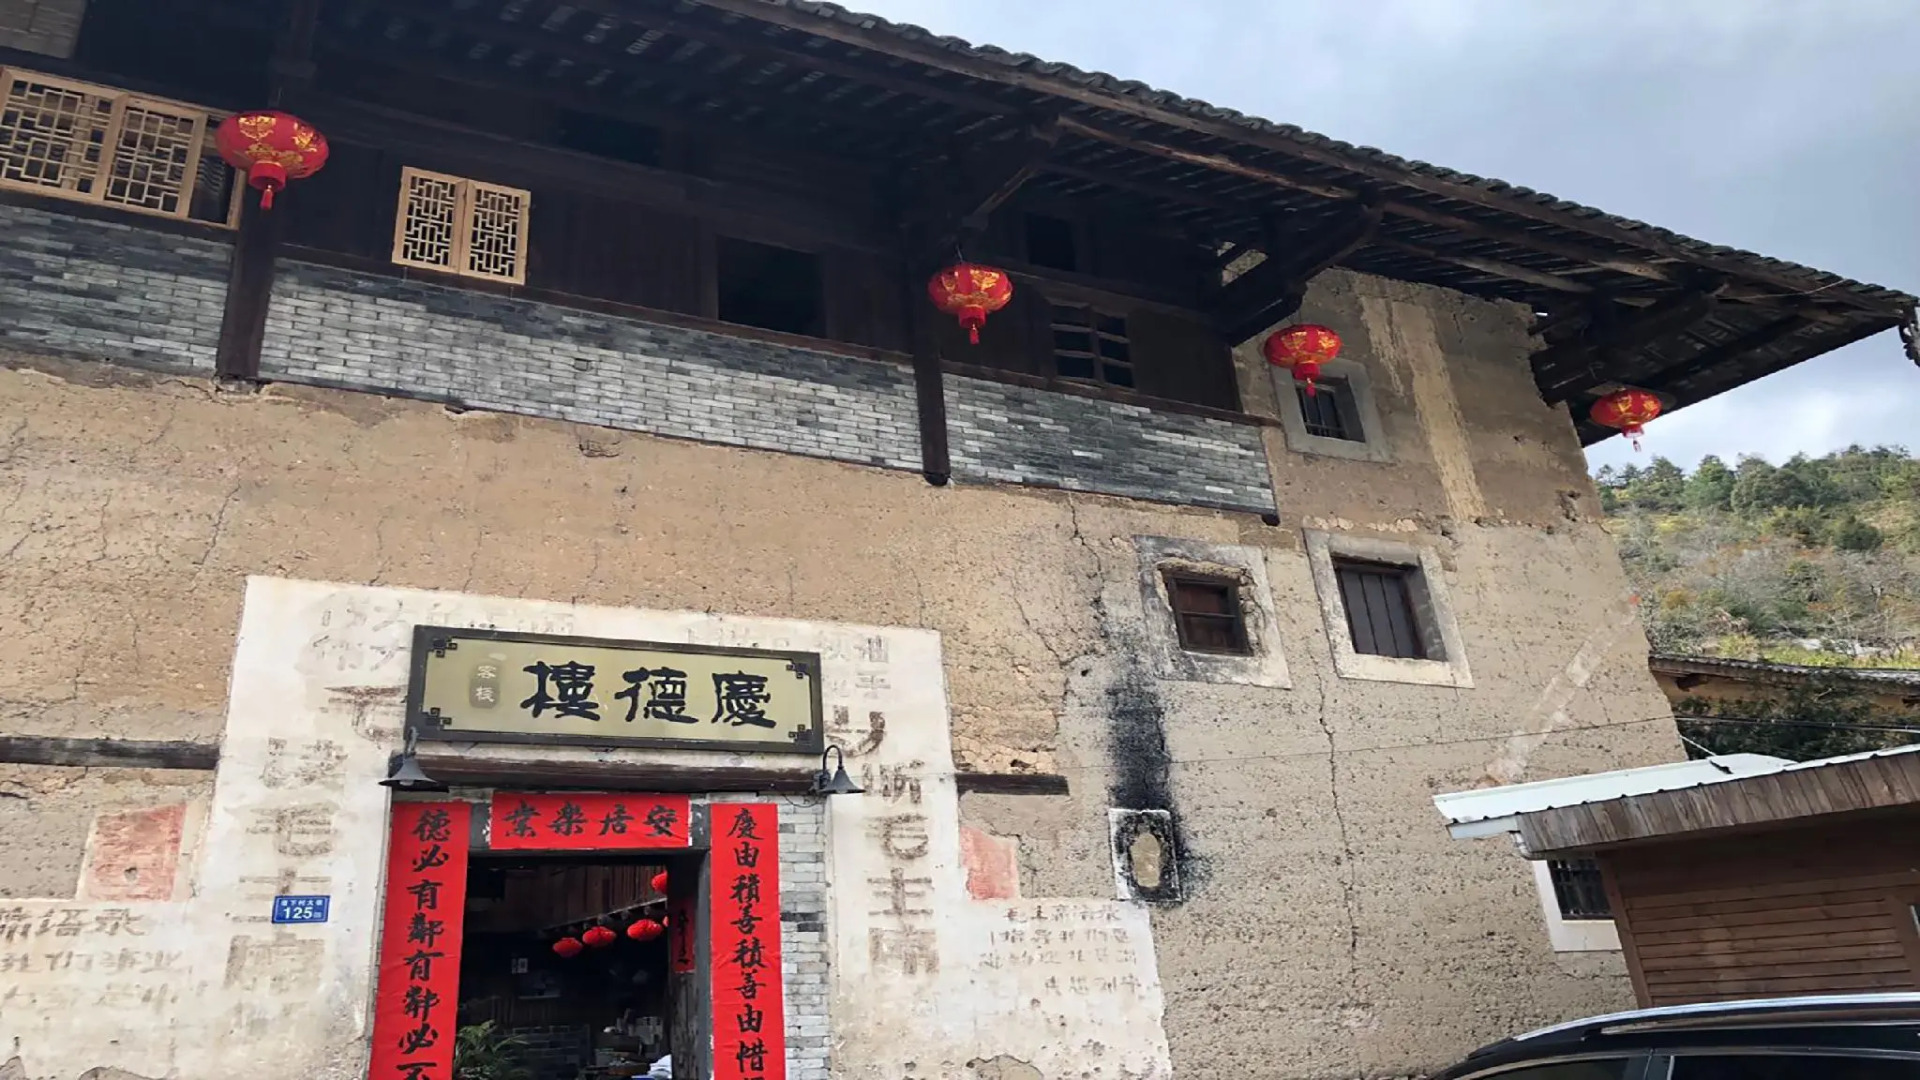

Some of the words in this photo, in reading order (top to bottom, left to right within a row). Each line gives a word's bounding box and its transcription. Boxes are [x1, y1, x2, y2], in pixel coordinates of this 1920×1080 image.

[727, 807, 768, 1080] 慶由積善積善由惜
